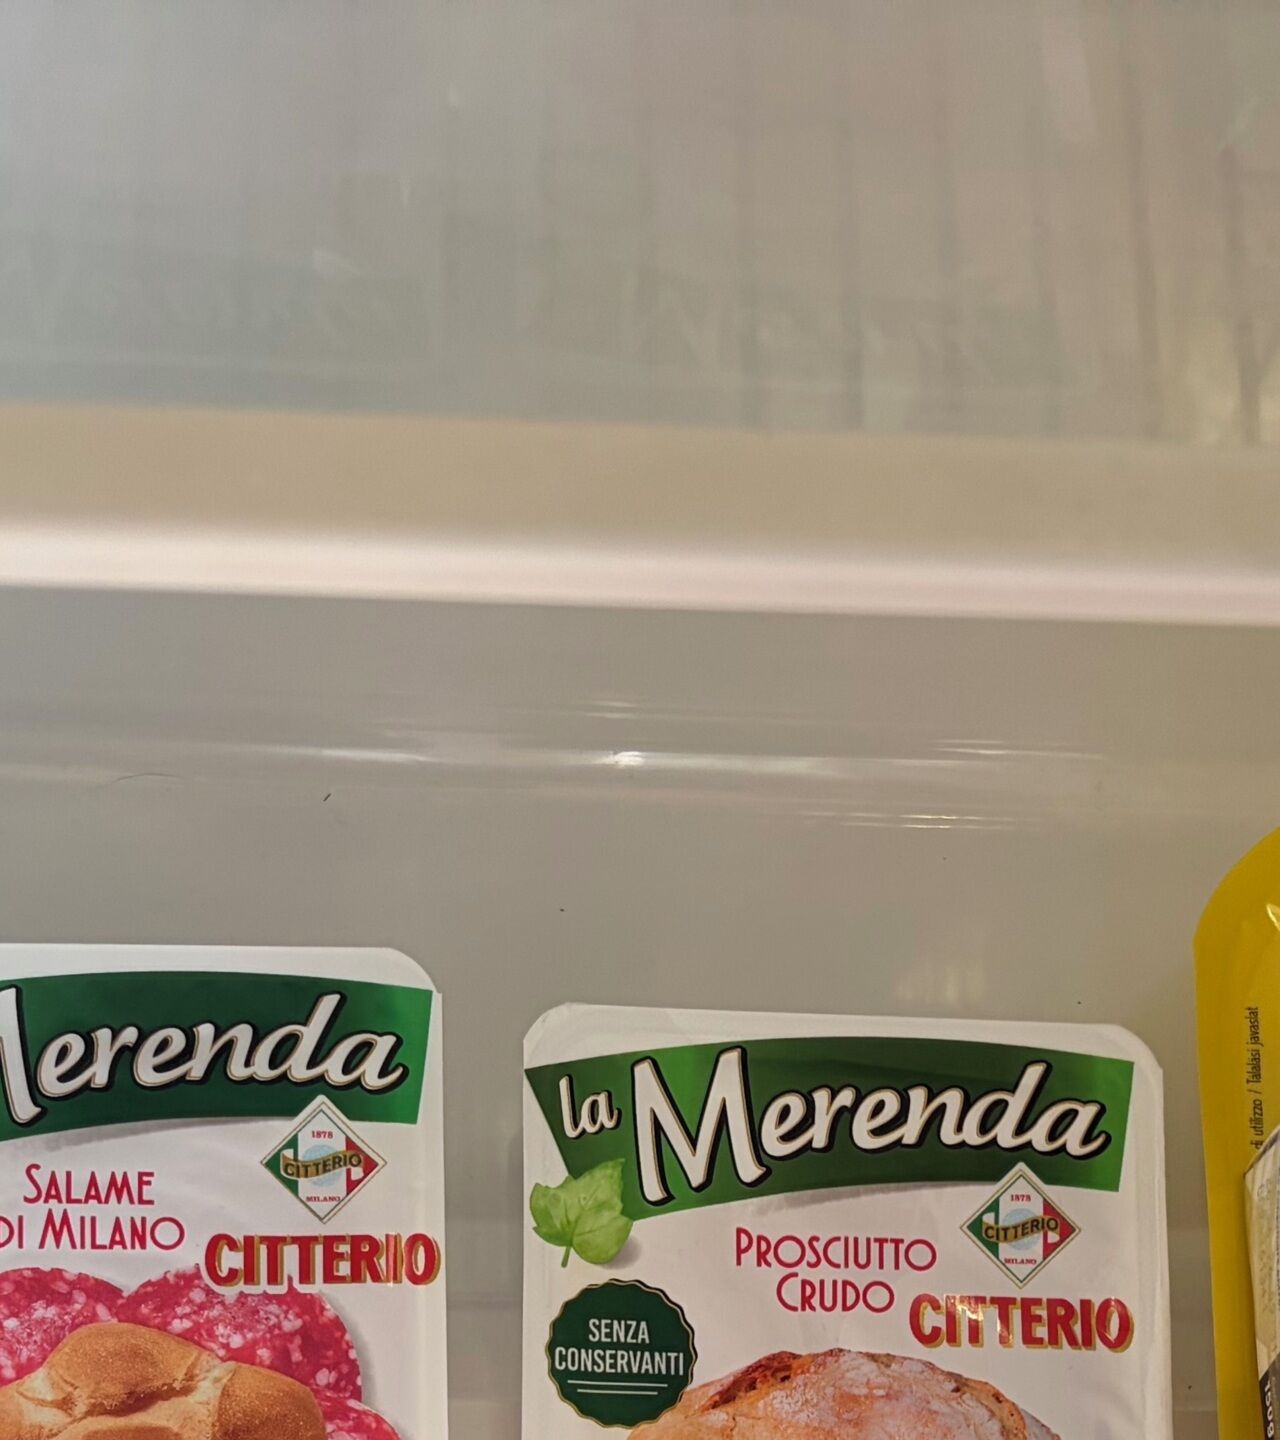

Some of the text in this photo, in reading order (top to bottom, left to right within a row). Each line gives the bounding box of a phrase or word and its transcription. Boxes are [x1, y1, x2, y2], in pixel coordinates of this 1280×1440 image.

[557, 1045, 1112, 1206] la Merenda
[23, 1162, 156, 1207] SALAME
[282, 1153, 363, 1179] CITTERIO
[38, 1208, 187, 1253] MILANO
[734, 1226, 939, 1273] PROSCIUTTO
[983, 1215, 1060, 1240] CITTERIO
[205, 1232, 441, 1289] CITTERIO
[775, 1271, 896, 1315] CRUDO
[587, 1318, 650, 1344] SENZA
[909, 1292, 1136, 1353] CITTERIO
[554, 1344, 686, 1377] CONSERVANTI
